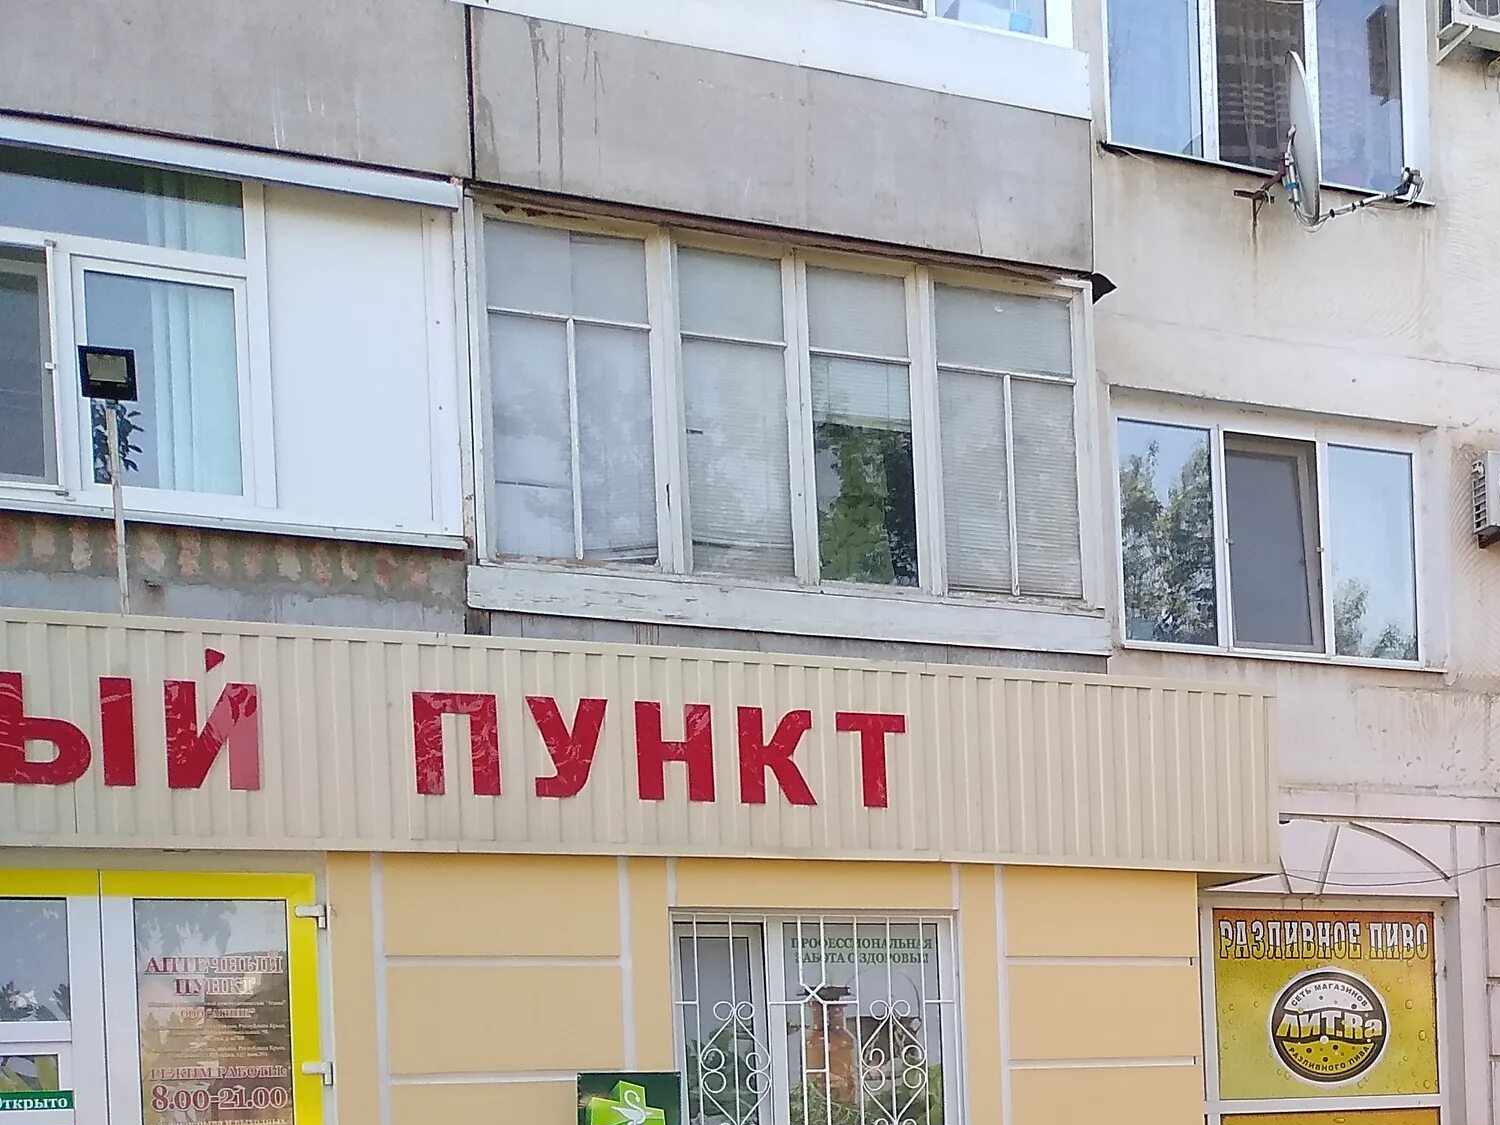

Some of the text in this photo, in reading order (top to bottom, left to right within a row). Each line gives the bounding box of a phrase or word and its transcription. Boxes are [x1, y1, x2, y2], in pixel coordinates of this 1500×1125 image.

[412, 692, 906, 808] ПУНКТ
[1219, 920, 1429, 960] РАЗЛИВНОЕ ПИВО
[144, 953, 284, 974] АПТЕЧНЫЙ
[173, 977, 256, 996] ПУНКТ
[1291, 983, 1368, 1007] СЕТЬ МАГАЗИНОВ
[1288, 1046, 1371, 1072] РАЗЛИВНОГО ПИВА
[0, 1097, 68, 1110] ткрыто
[151, 1083, 288, 1112] 8.00-21.00
